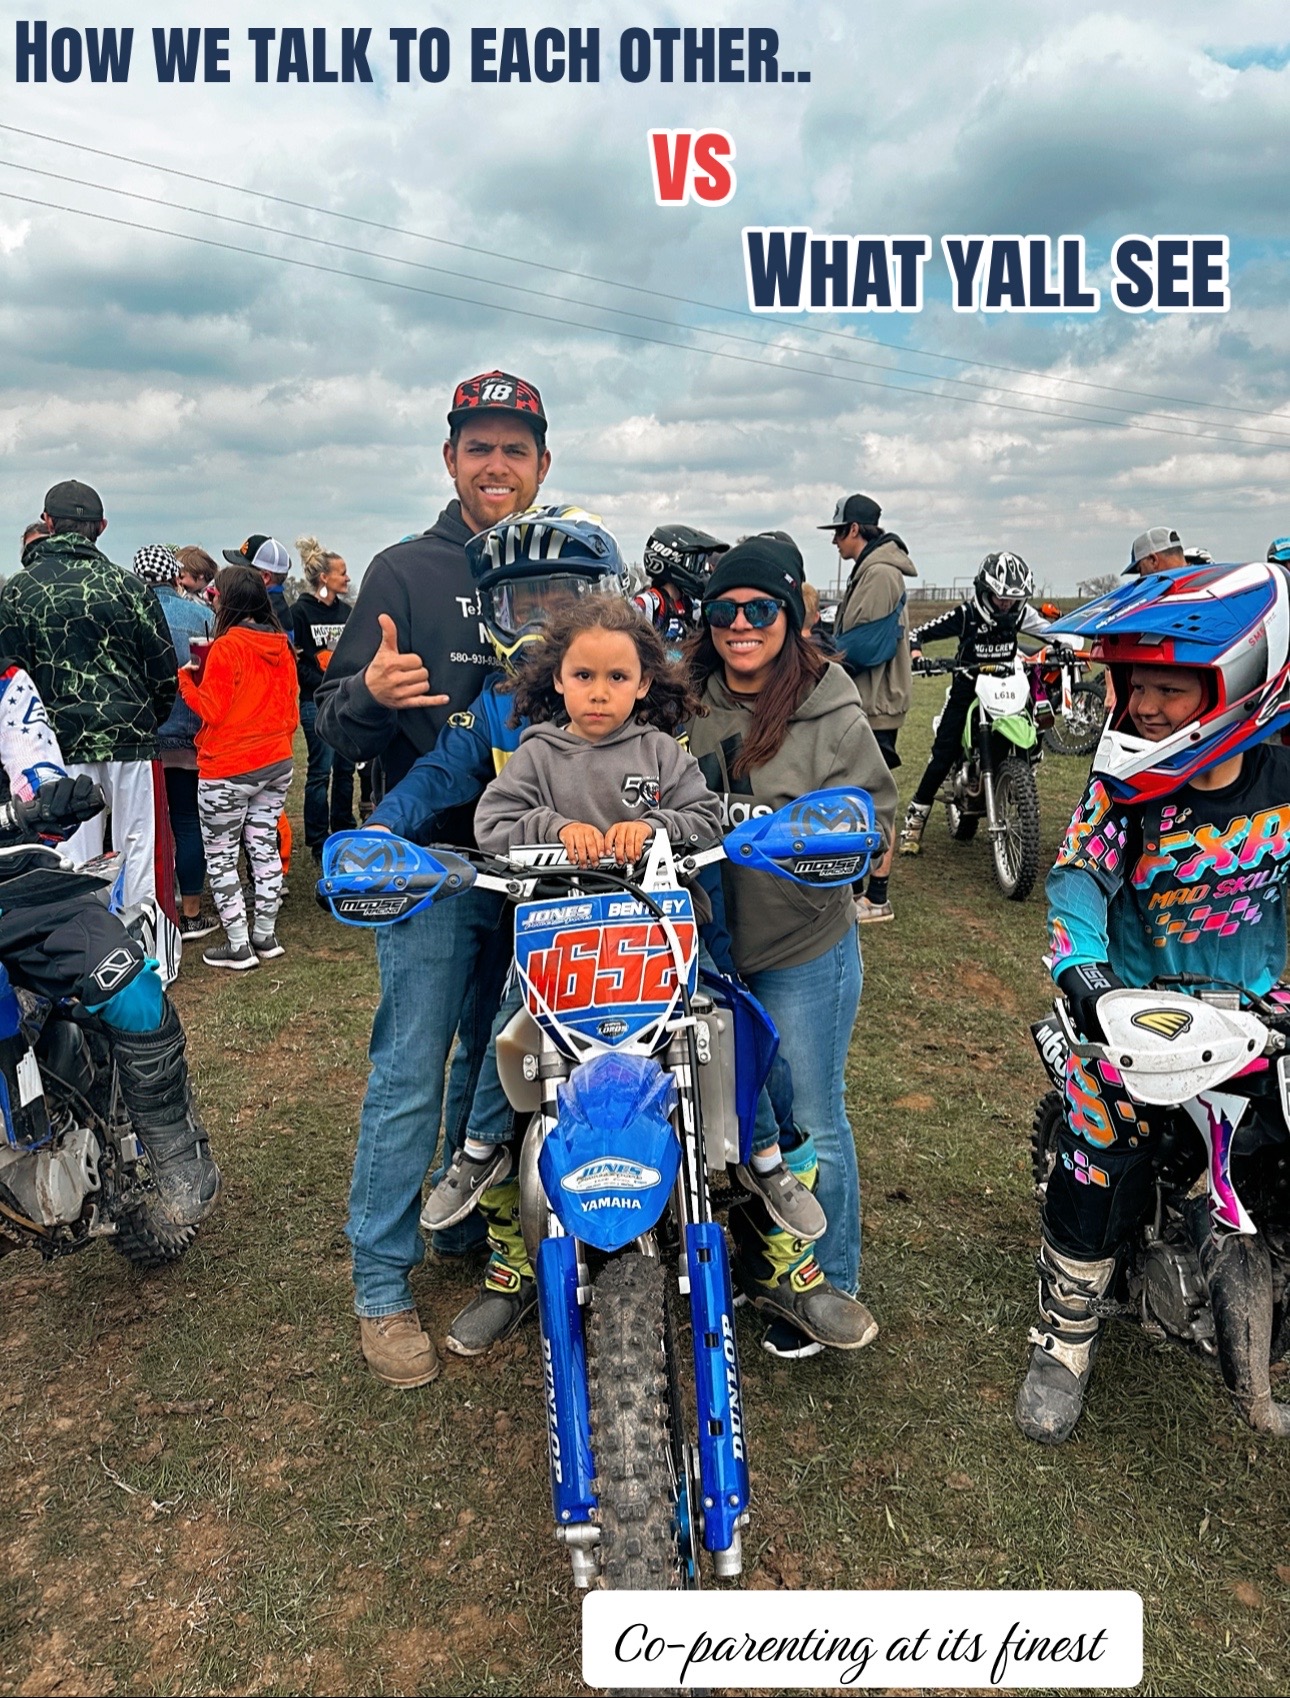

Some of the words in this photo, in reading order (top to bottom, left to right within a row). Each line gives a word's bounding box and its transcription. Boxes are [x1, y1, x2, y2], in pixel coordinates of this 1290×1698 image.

[481, 383, 513, 402] 18
[649, 540, 684, 564] 100%
[995, 641, 1015, 652] CREW
[994, 691, 1016, 700] L618
[794, 856, 860, 873] MOOSE
[340, 897, 407, 911] MOOSE
[1147, 884, 1211, 911] MAD
[522, 903, 594, 925] JONES
[608, 899, 687, 917] BENTEY
[582, 1162, 644, 1178] JONES
[581, 1196, 642, 1213] YAMAHA
[720, 1313, 745, 1463] DUNLOP
[543, 1337, 563, 1485] DUNLOP
